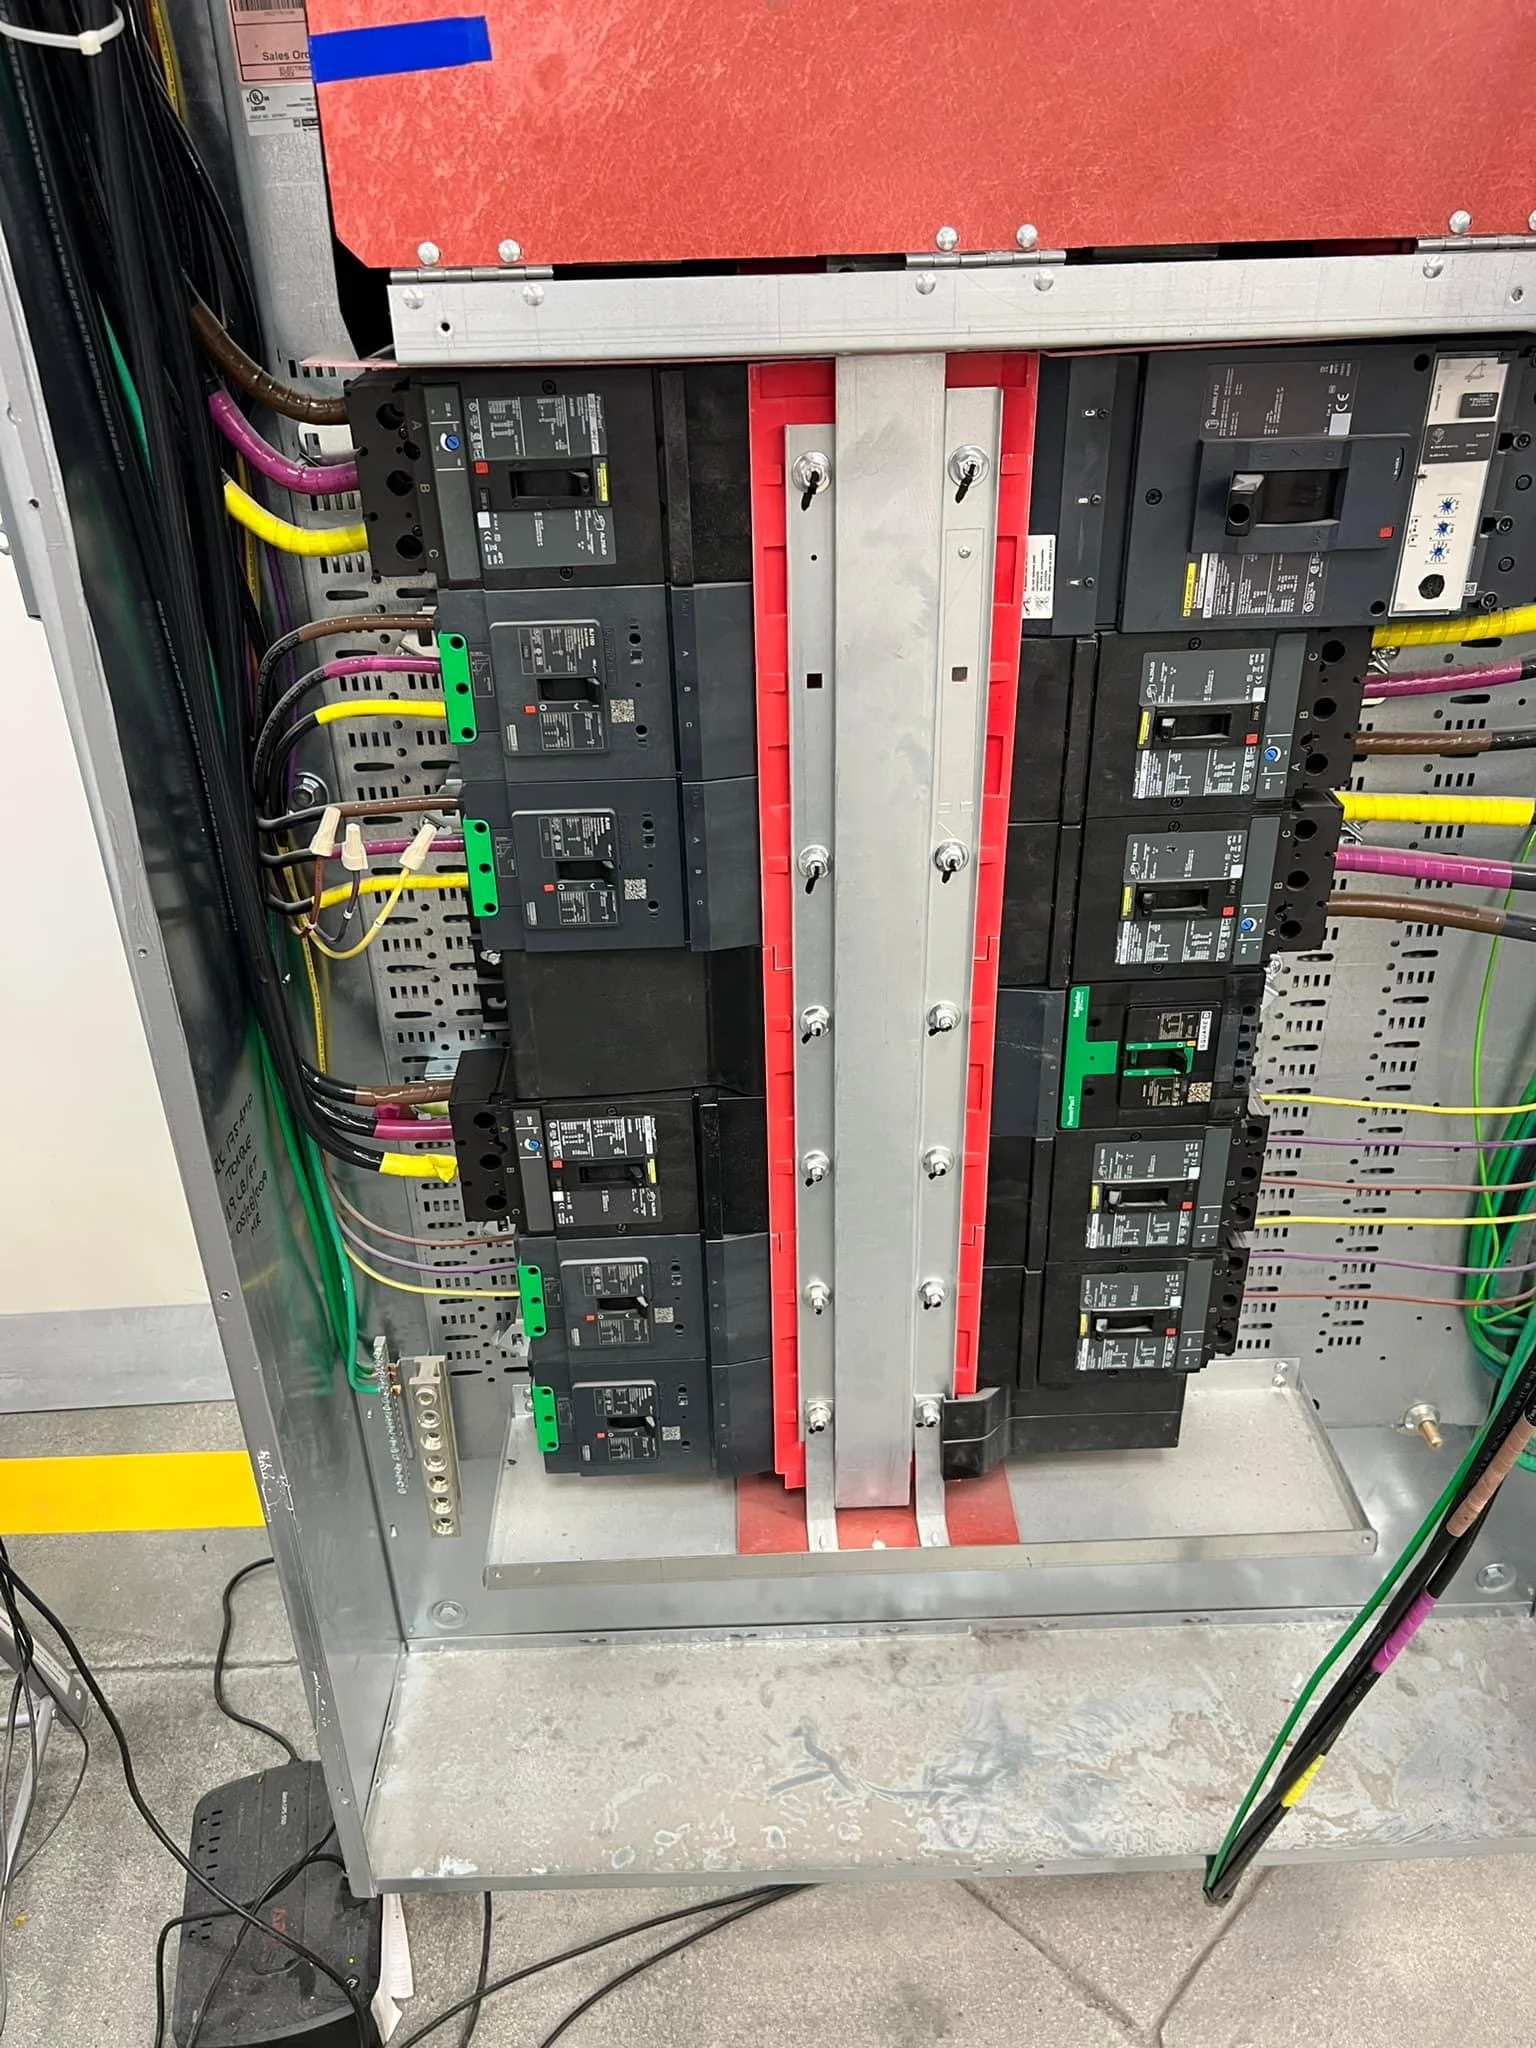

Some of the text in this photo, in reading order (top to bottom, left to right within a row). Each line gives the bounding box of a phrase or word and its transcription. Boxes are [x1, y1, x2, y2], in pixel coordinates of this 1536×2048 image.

[262, 51, 290, 61] Sales
[411, 420, 423, 431] A
[420, 483, 431, 493] B
[428, 549, 439, 558] C
[1308, 652, 1318, 661] C
[1299, 710, 1309, 720] B
[1291, 762, 1301, 772] A
[1282, 830, 1292, 838] C
[1267, 928, 1277, 937] A
[1200, 1020, 1209, 1049] SQUARE
[500, 1126, 510, 1134] A
[511, 1208, 521, 1216] C
[1222, 1219, 1231, 1227] A
[1214, 1268, 1223, 1276] C
[1203, 1342, 1213, 1350] A
